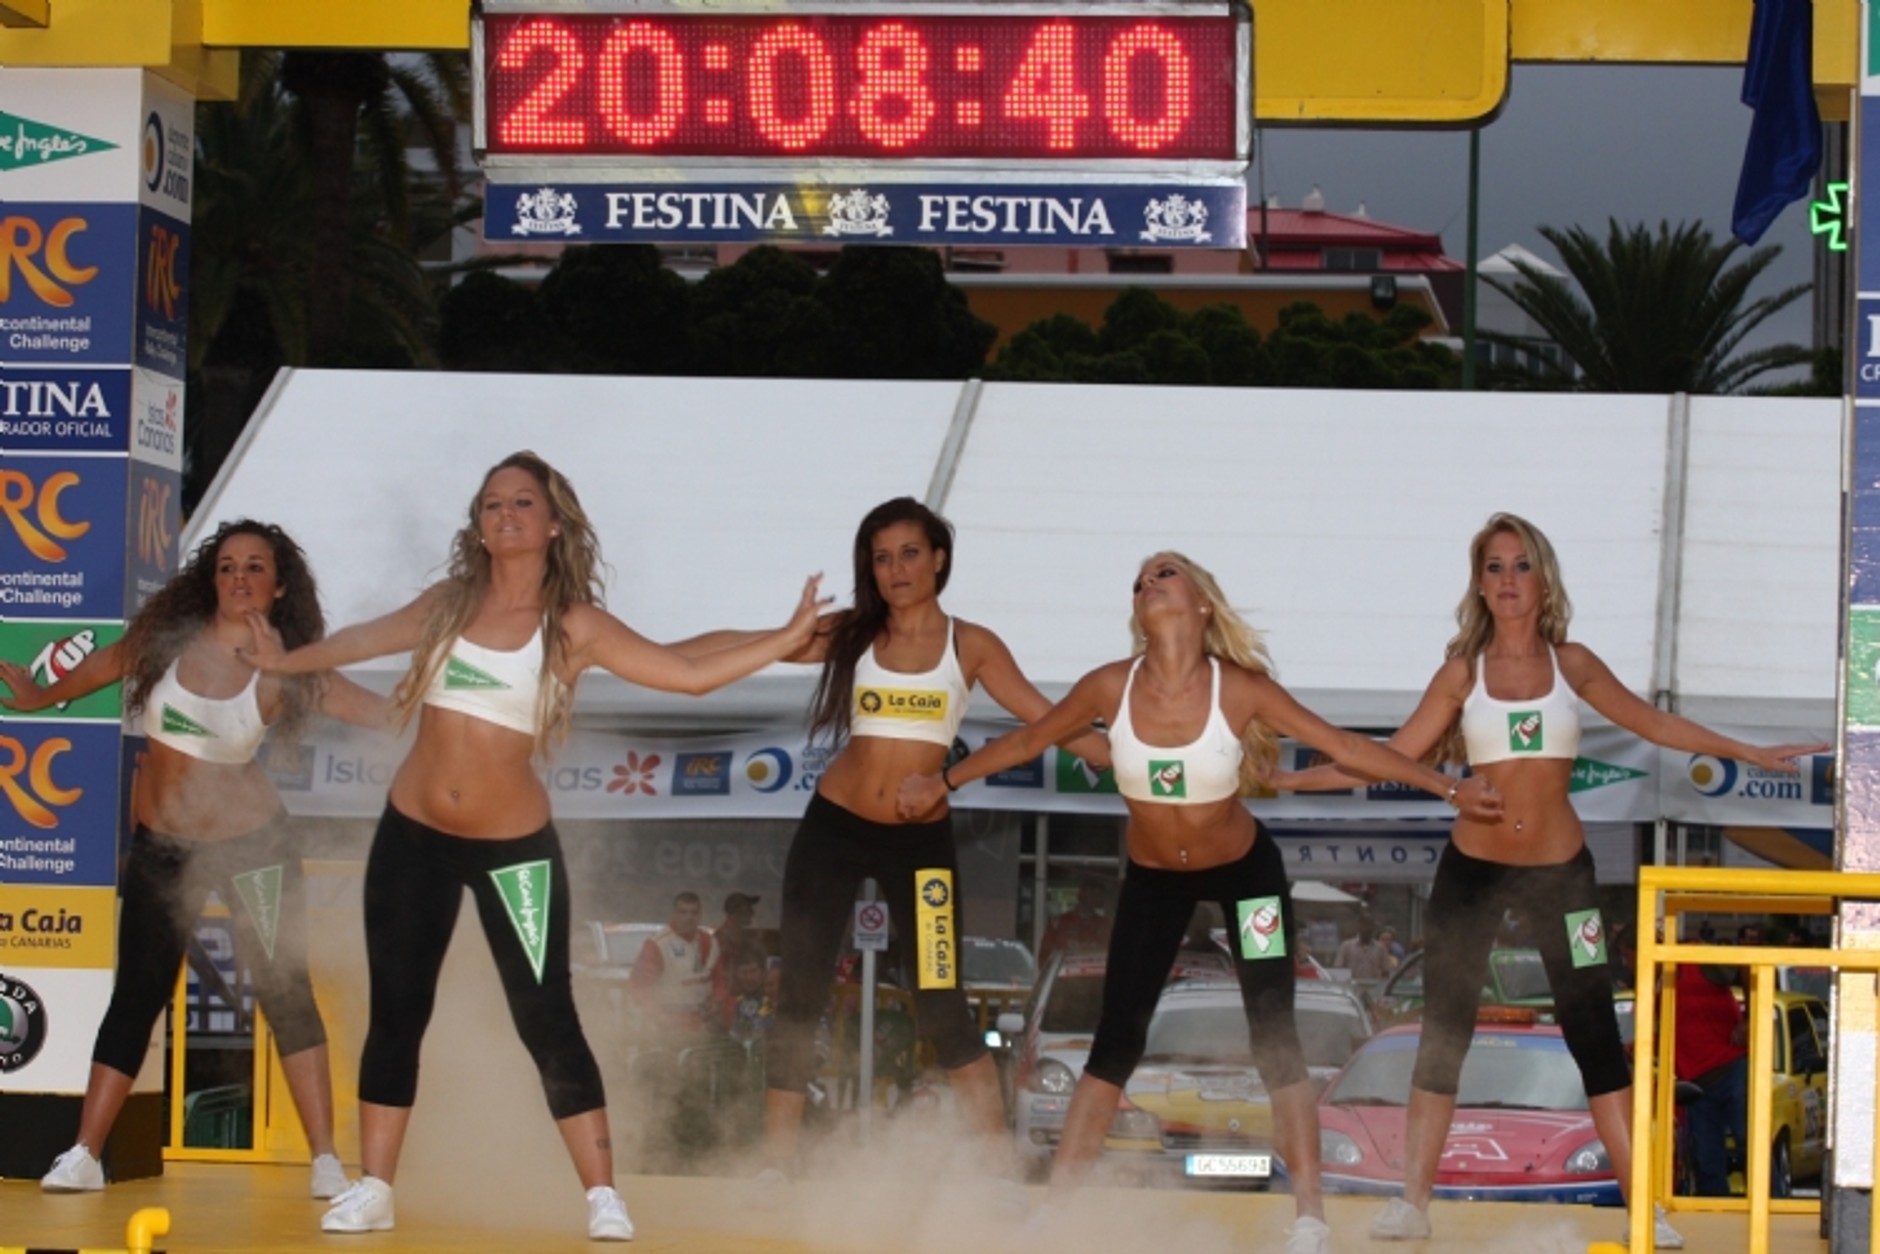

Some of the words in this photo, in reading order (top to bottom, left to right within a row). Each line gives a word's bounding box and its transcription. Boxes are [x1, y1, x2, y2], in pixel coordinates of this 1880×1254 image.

[499, 22, 1190, 149] 20:08:40
[605, 192, 798, 231] FESTINA
[917, 194, 1115, 235] FESTINA
[0, 216, 98, 307] RC
[0, 316, 91, 332] continental
[9, 333, 90, 352] Challenge
[0, 381, 111, 418] TINA
[0, 421, 51, 436] RADOR
[55, 421, 112, 438] OFICIAL
[0, 470, 91, 563] RC
[0, 571, 83, 587] ontinental
[2, 588, 82, 608] Challenge
[909, 694, 942, 708] Caja
[0, 736, 84, 829] RC
[325, 754, 391, 785] Isla
[1738, 779, 1802, 799] .com
[0, 913, 13, 932] a
[21, 908, 82, 934] Caja
